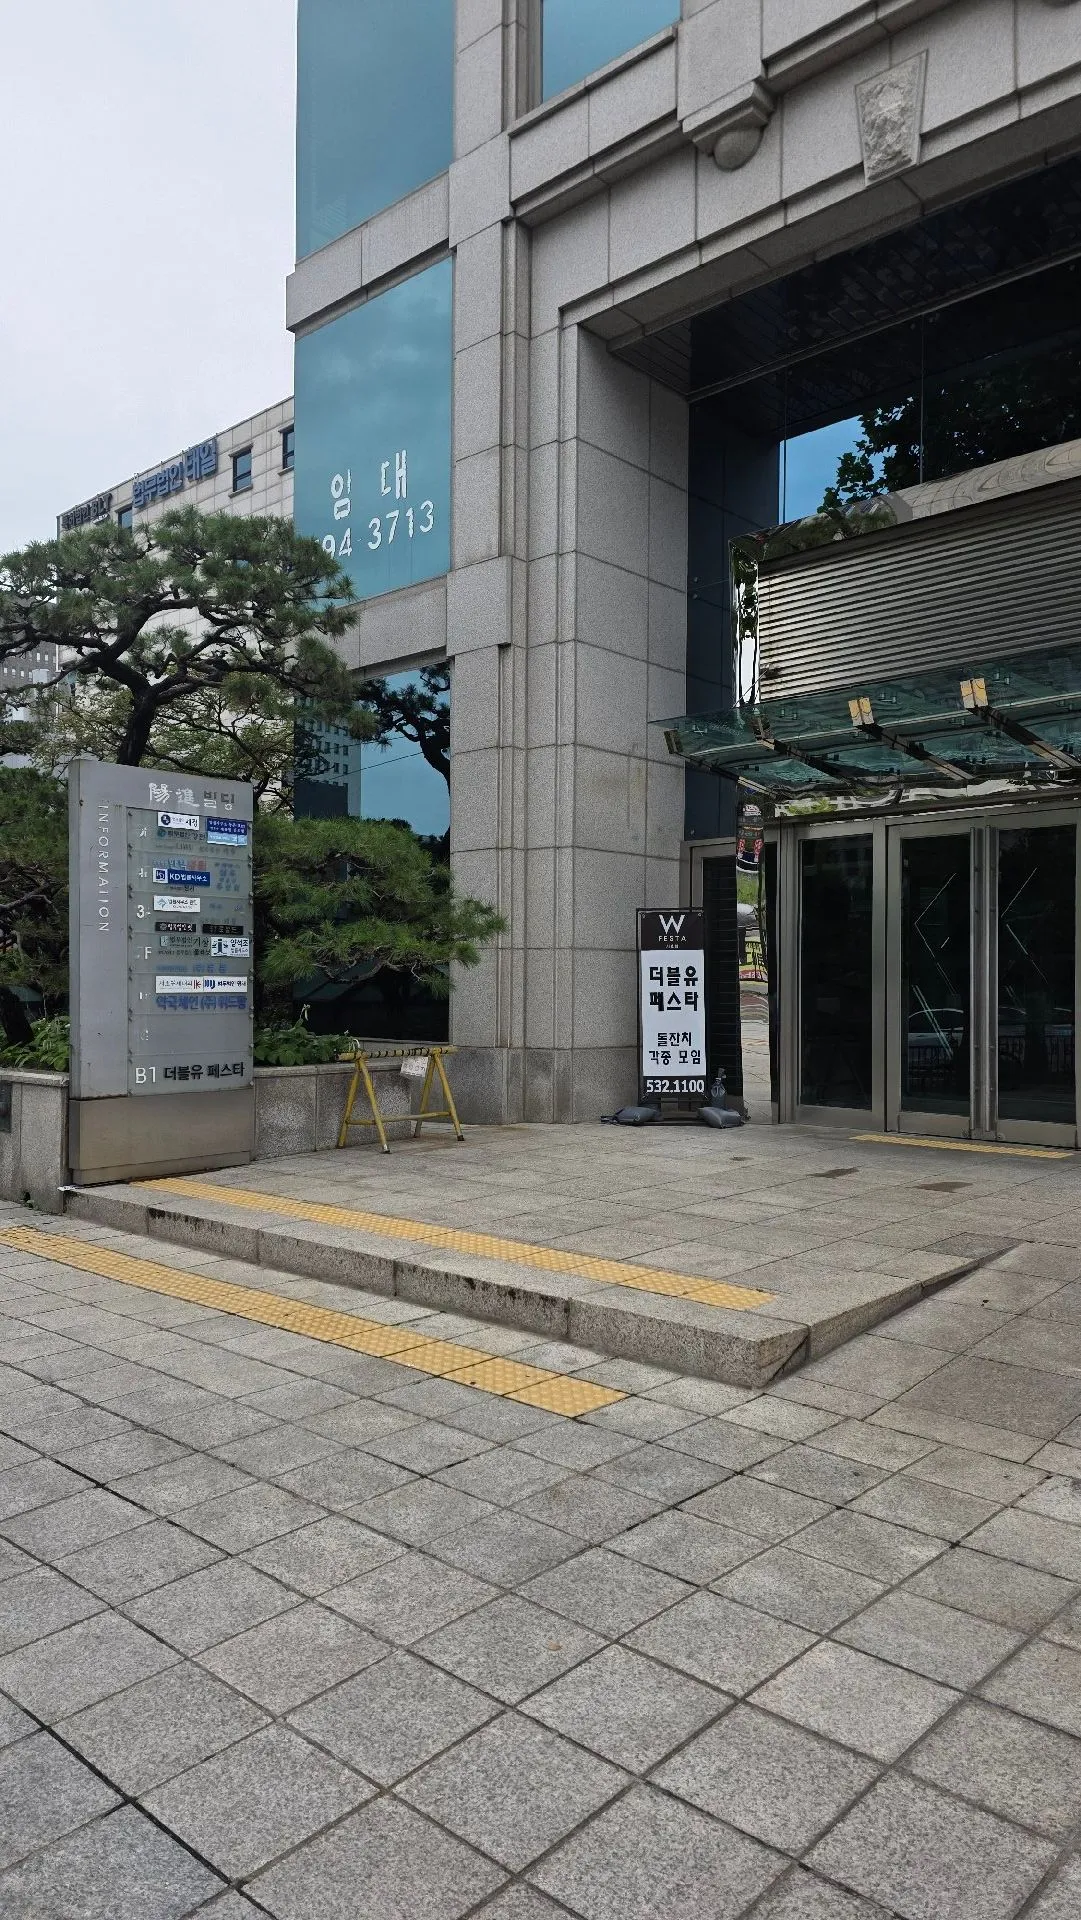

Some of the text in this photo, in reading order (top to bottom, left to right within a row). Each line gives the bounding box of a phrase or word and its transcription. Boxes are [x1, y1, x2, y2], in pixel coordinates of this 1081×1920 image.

[132, 438, 218, 508] 법무법인 태일
[331, 449, 407, 521] 임 대
[91, 493, 112, 516] BLT
[315, 500, 434, 559] 94 3713
[658, 914, 686, 935] W
[230, 938, 249, 948] 양석조
[649, 965, 699, 987] 더블유
[657, 1031, 692, 1047] 돌잔치
[648, 1049, 701, 1066] 각종 모임
[135, 1061, 246, 1084] B1 더블유 페스타
[646, 1079, 705, 1093] 532.1100
